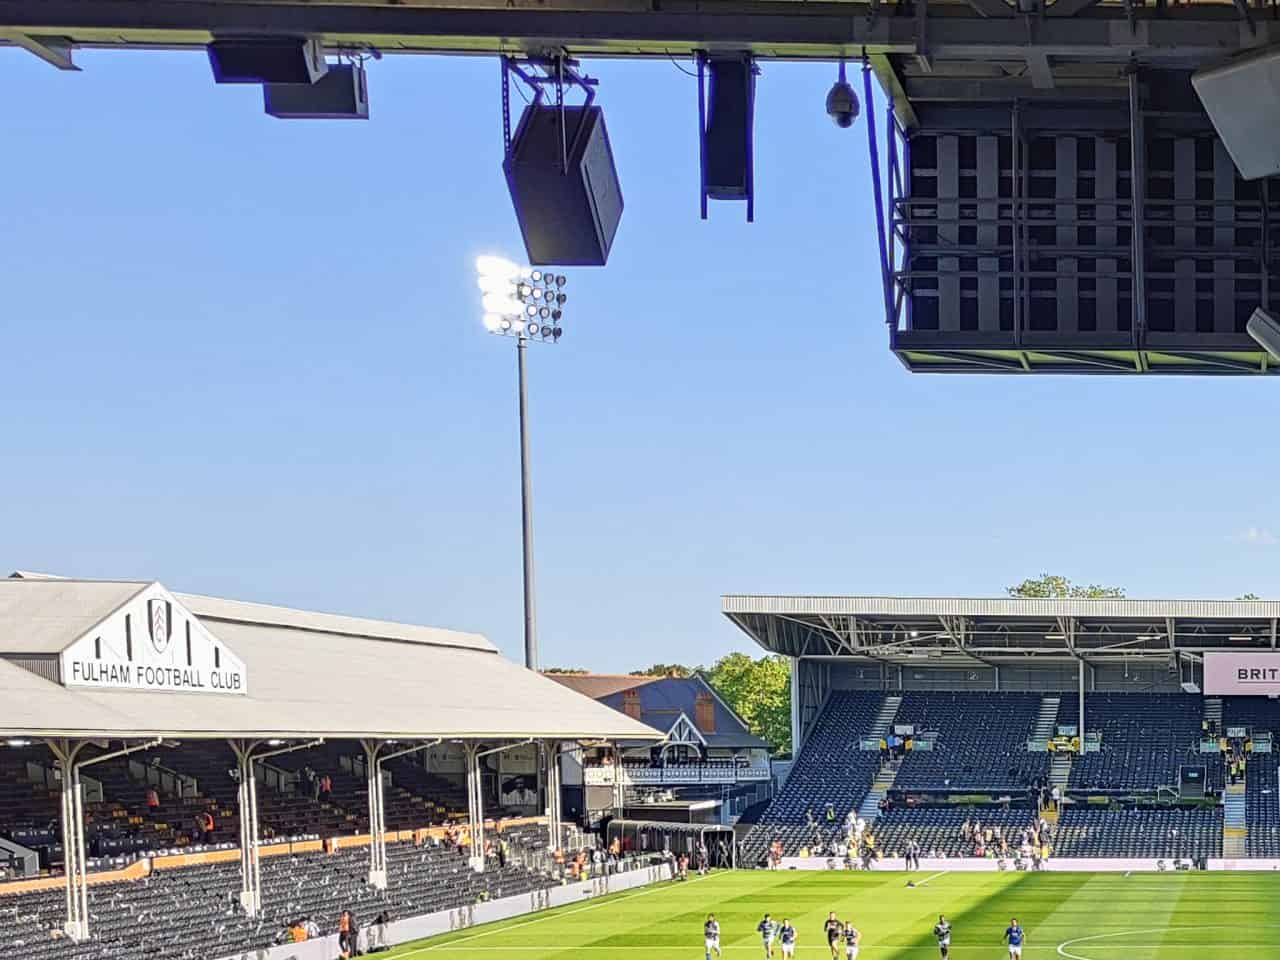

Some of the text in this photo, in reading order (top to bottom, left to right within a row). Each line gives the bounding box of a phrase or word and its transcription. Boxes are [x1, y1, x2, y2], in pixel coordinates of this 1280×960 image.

[72, 661, 241, 689] FULHAM FOOTBALL CLUB
